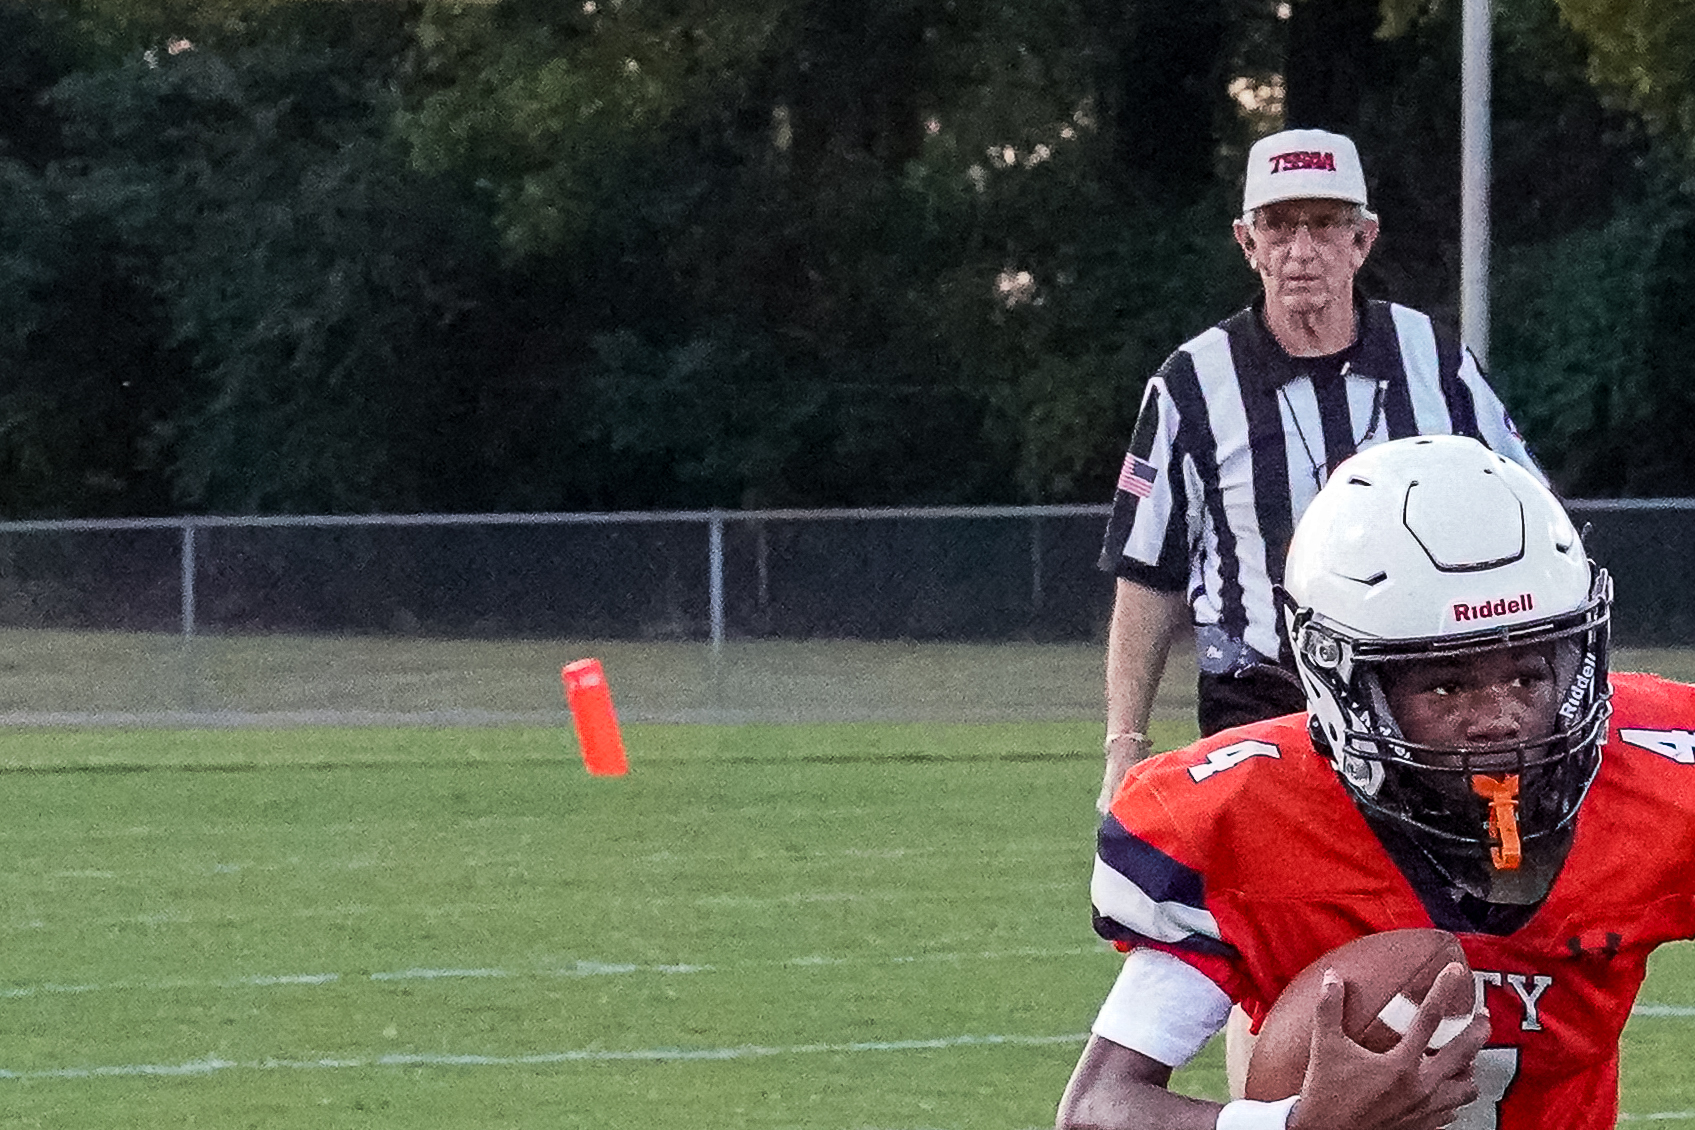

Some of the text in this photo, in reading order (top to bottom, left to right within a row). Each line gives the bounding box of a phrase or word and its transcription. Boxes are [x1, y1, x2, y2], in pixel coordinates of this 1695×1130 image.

[1454, 594, 1534, 622] Riddell
[1559, 652, 1597, 719] Riddell
[1187, 740, 1281, 783] 4
[1474, 971, 1552, 1030] TY
